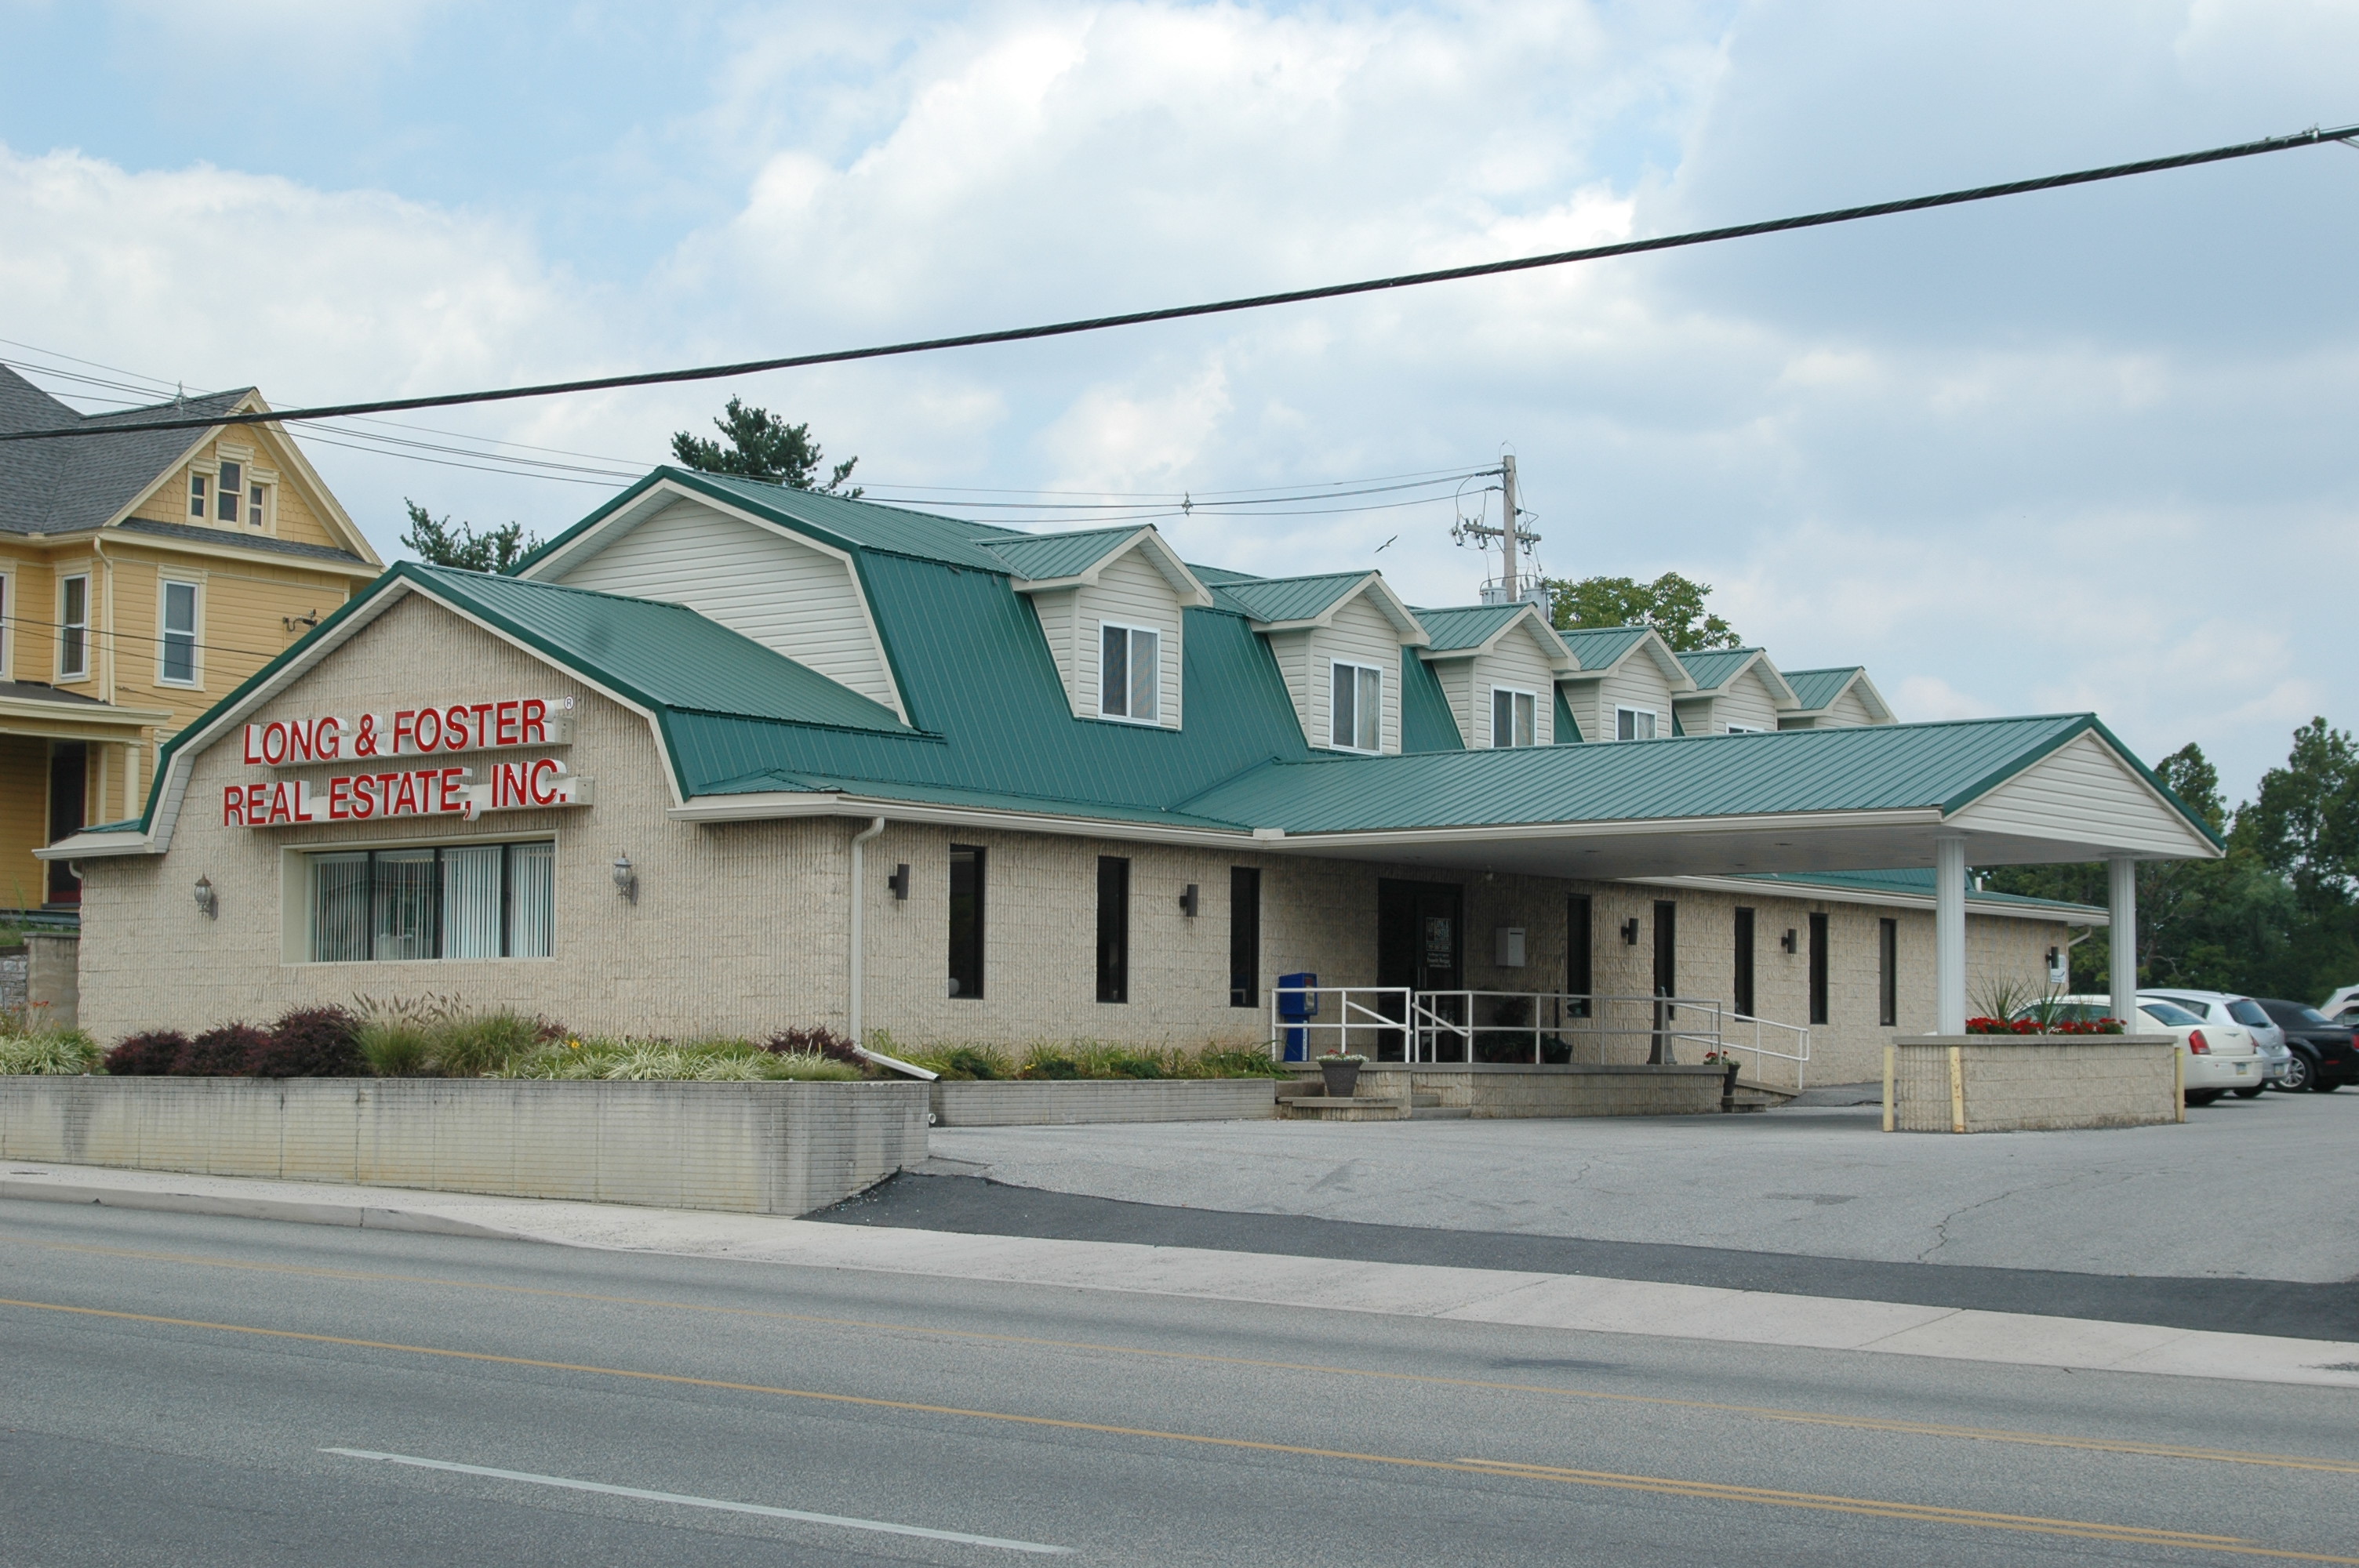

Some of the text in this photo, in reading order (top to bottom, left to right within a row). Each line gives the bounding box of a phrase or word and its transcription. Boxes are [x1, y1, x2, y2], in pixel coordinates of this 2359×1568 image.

[243, 716, 340, 765] LONG
[354, 713, 378, 757] &
[392, 698, 547, 754] FOSTER
[224, 758, 567, 826] REAL ESTATE, INC.
